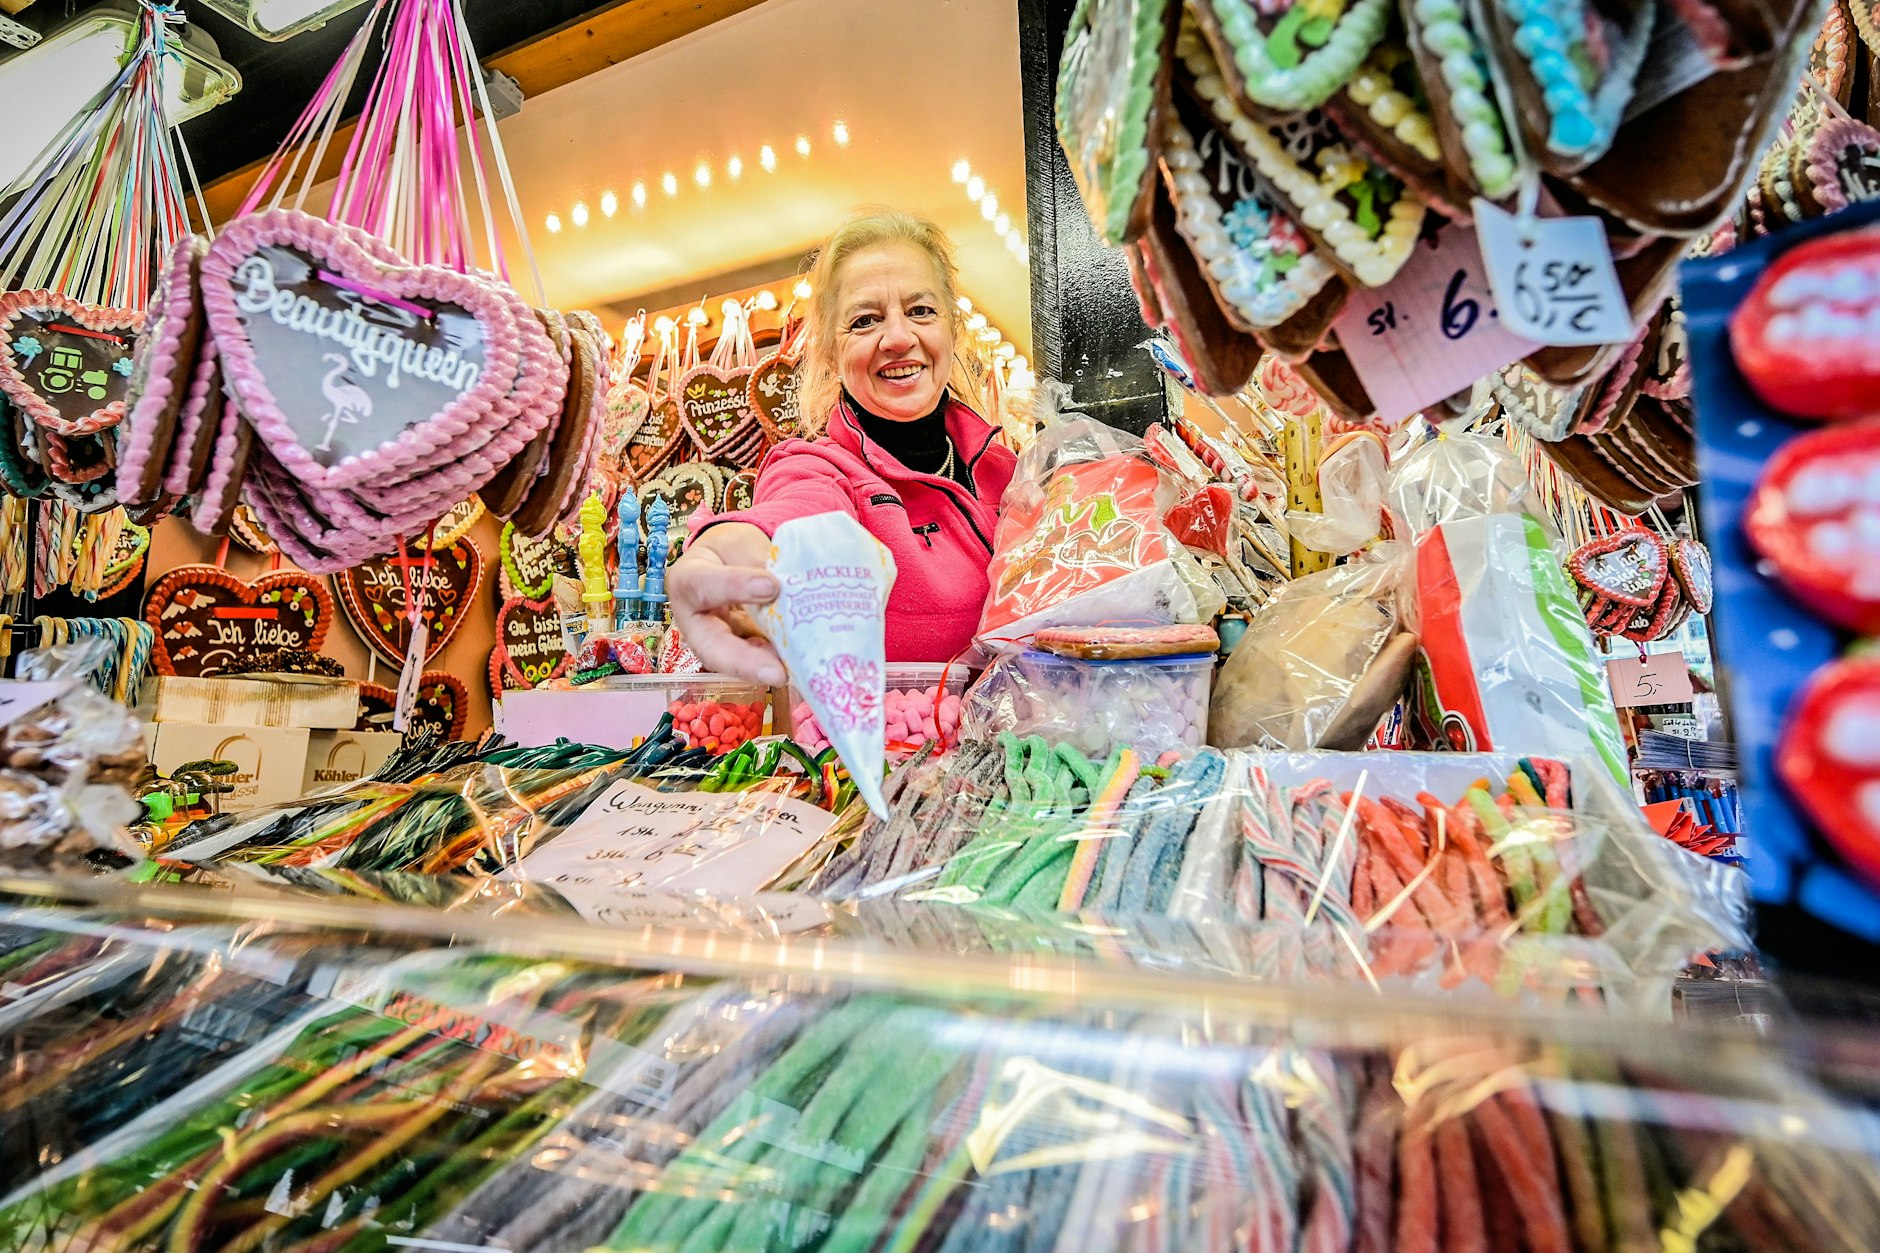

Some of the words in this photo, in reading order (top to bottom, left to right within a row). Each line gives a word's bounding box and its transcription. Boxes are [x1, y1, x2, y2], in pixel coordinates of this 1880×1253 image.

[234, 256, 480, 391] Beautyqueen
[362, 565, 402, 586] Ich
[409, 566, 452, 590] liebe
[806, 566, 874, 581] FACKLER
[207, 618, 247, 648] Ich
[251, 618, 303, 648] liebe
[508, 620, 531, 637] Du
[533, 613, 560, 634] bist
[508, 639, 538, 658] mein
[537, 634, 566, 656] Glüc
[313, 769, 360, 783] Köhler
